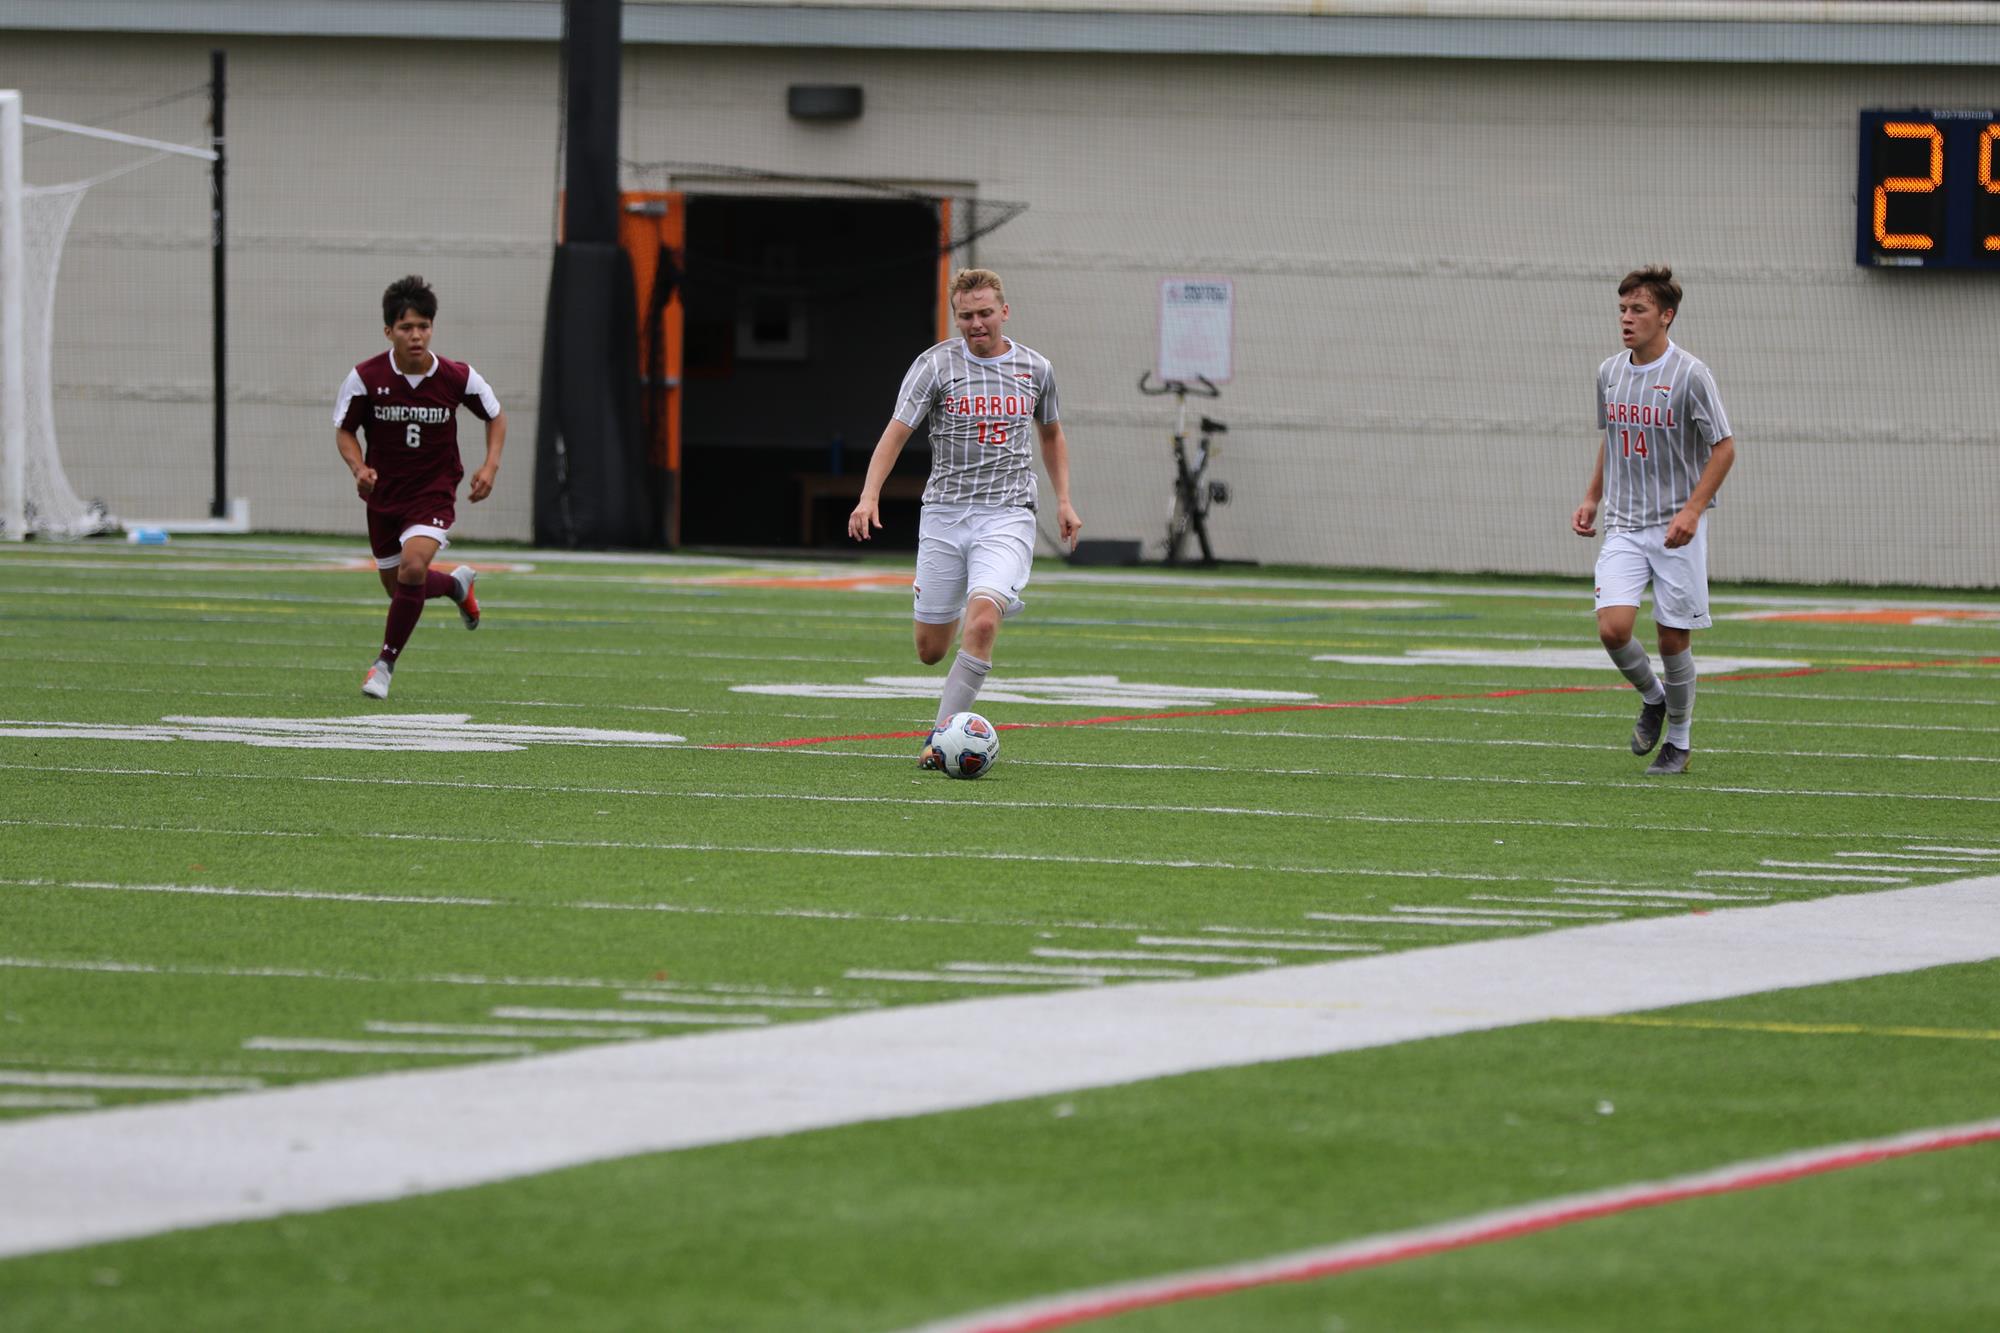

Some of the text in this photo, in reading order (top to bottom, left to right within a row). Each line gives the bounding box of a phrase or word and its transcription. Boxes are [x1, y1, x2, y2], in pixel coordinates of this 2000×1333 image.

[374, 406, 451, 423] CONCORDIA
[1604, 401, 1677, 428] ARROLL
[406, 423, 421, 448] 6
[976, 421, 1010, 446] 15
[1621, 430, 1648, 459] 14
